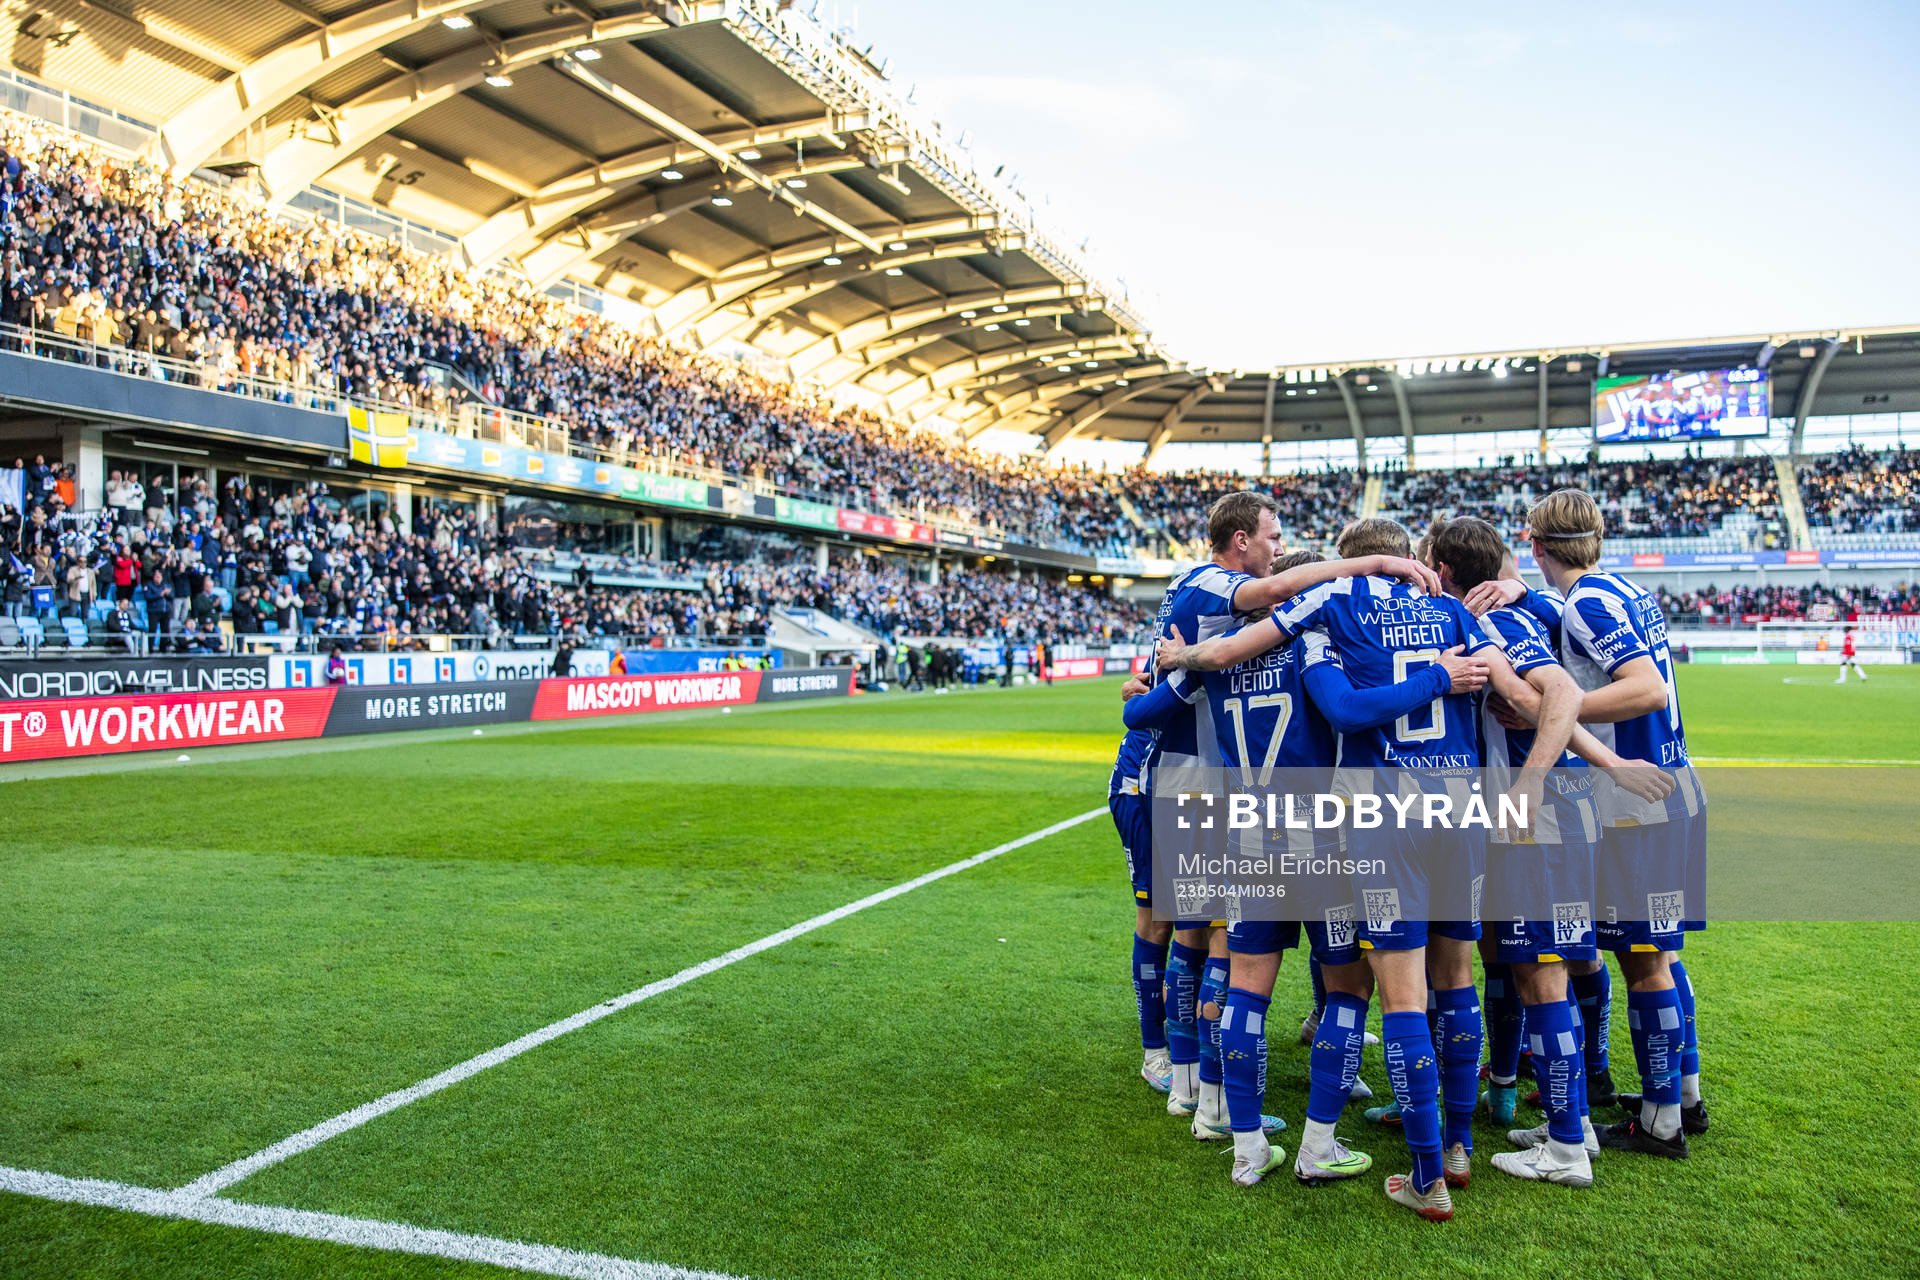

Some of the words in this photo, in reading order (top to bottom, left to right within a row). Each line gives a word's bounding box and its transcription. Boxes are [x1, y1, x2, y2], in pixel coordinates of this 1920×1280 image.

[1358, 610, 1452, 625] WELLNESS
[1381, 624, 1445, 647] HAGEN
[1594, 623, 1632, 650] morris
[1599, 641, 1627, 661] law.
[654, 676, 742, 705] WORKWEAR
[1231, 668, 1283, 694] WENDT
[366, 696, 421, 720] MORE
[427, 691, 507, 716] STRETCH
[60, 698, 285, 748] WORKWEAR
[1223, 692, 1293, 788] 17
[1365, 892, 1391, 905] EFF
[1651, 894, 1677, 908] EFF
[1367, 904, 1396, 917] EKT
[1555, 905, 1582, 918] EFF
[1606, 906, 1618, 925] 3
[1652, 904, 1681, 919] EKT
[1512, 915, 1526, 935] 2
[1557, 917, 1587, 930] EKT
[1340, 1032, 1362, 1090] SILFVERLOK
[1387, 1042, 1415, 1113] SILFVERLOK
[1550, 1059, 1569, 1113] SILFVERLOK
